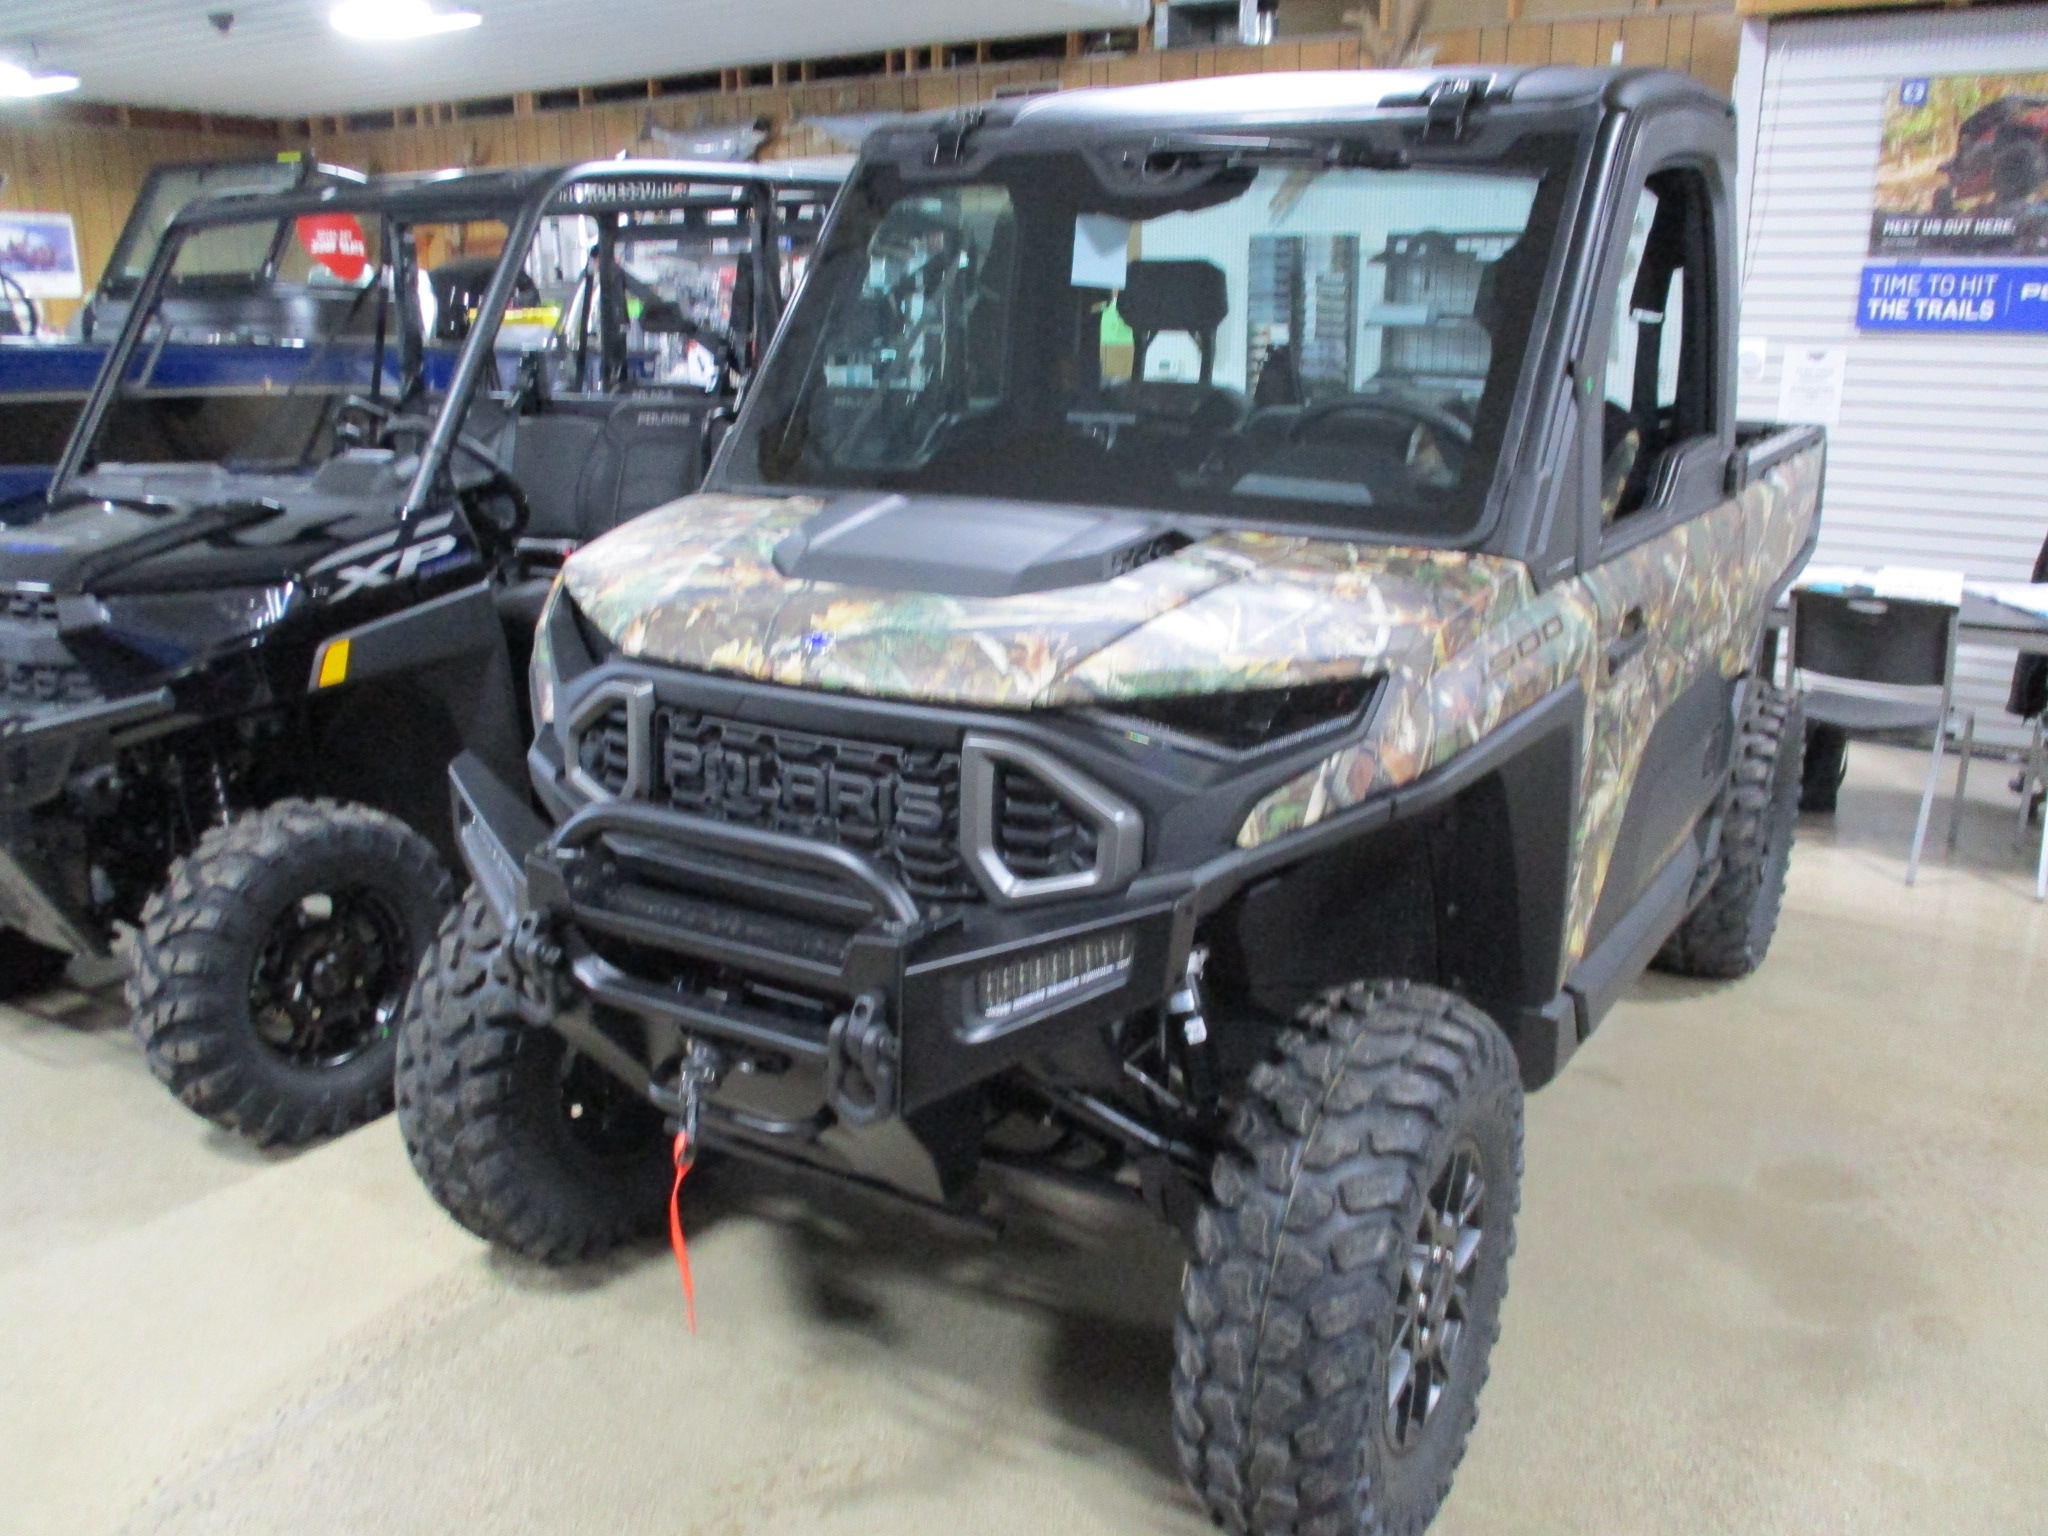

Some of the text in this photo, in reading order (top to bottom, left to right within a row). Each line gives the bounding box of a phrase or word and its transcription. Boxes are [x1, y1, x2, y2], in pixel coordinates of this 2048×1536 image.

[1882, 218, 1921, 236] MEET
[1922, 219, 1942, 236] US
[1943, 219, 1973, 236] OUT
[1871, 273, 1999, 298] TIME TO HIT
[1867, 298, 1995, 322] THE TRAILS
[327, 534, 457, 605] XP
[664, 739, 943, 830] POLARIS
